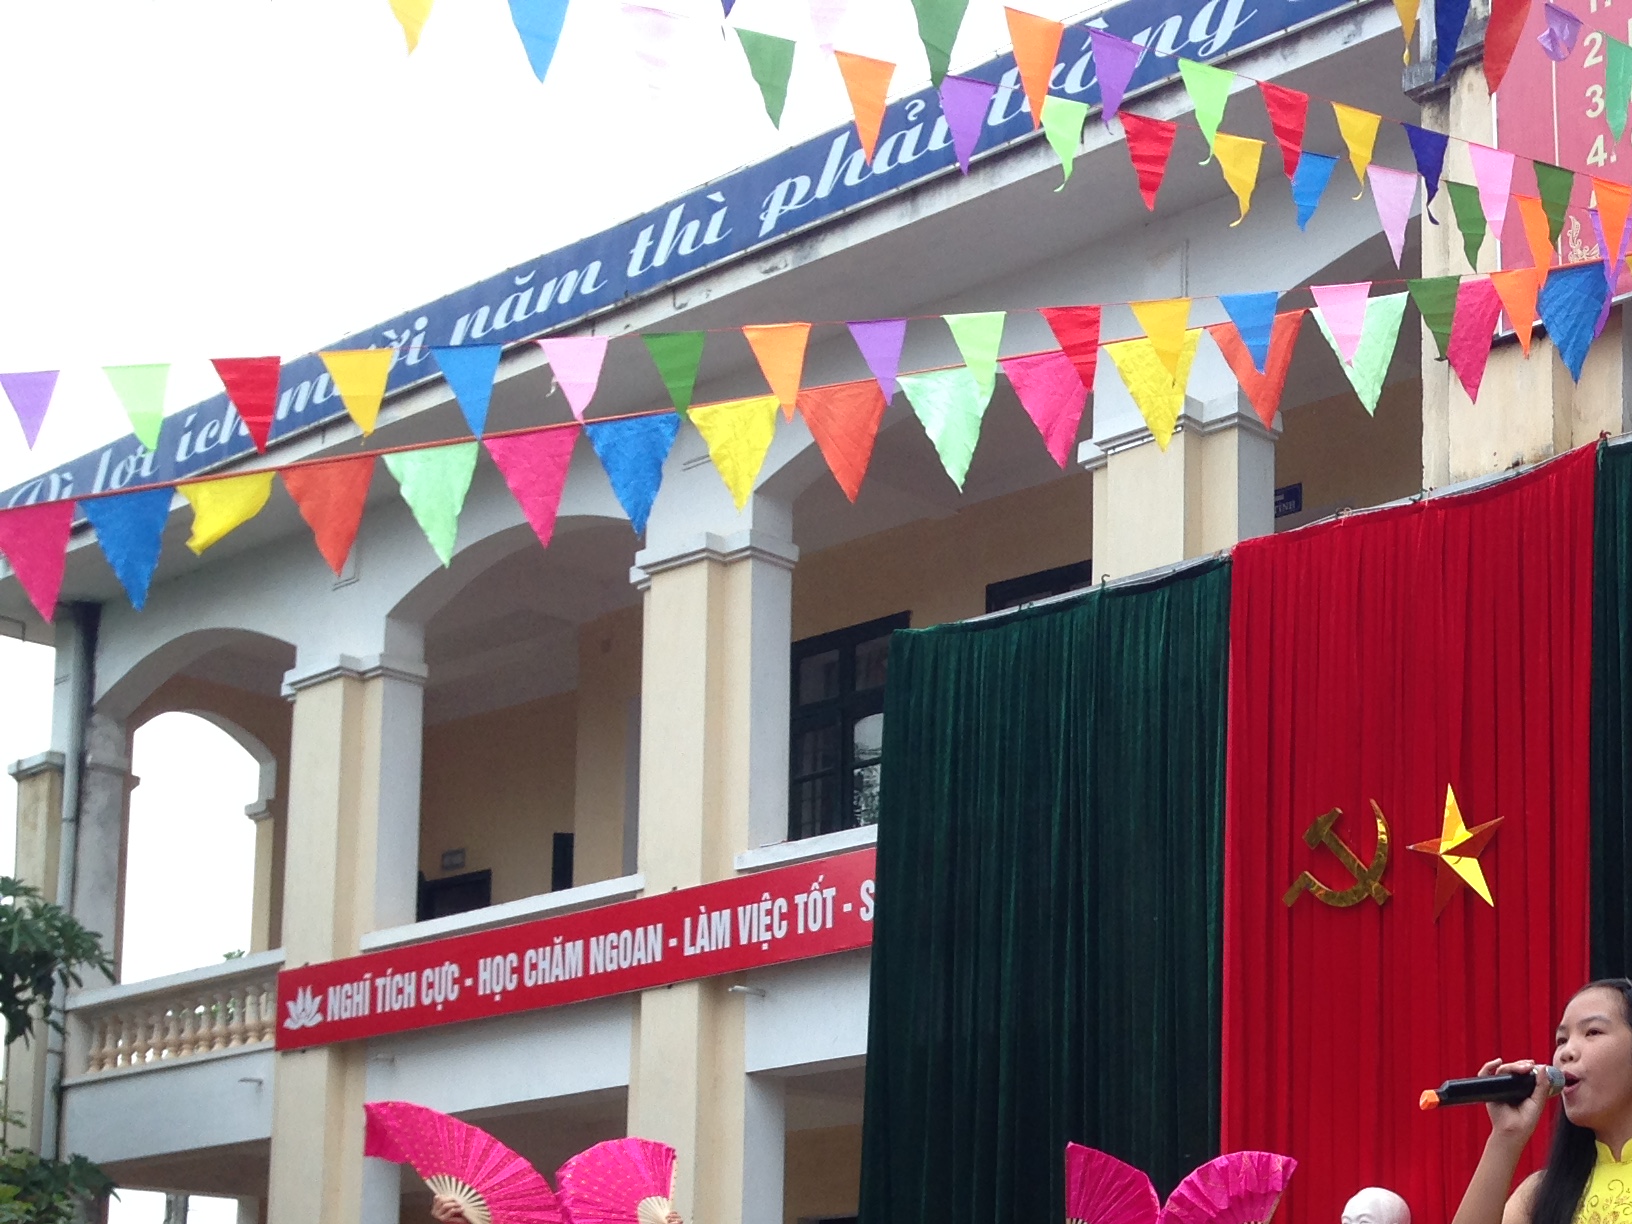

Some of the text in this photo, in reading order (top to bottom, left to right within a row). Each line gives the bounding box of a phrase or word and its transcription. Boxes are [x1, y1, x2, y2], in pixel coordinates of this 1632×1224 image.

[450, 260, 607, 346] năm
[627, 192, 732, 278] thì
[376, 968, 417, 1013] TÍCH
[421, 961, 460, 1011] CỰC
[478, 953, 518, 1001] HỌC
[524, 936, 584, 987] CHĂM
[589, 923, 663, 975] NGOAN
[683, 906, 731, 956] LÀM
[738, 892, 788, 951] VIỆC
[795, 875, 836, 934] TỐT
